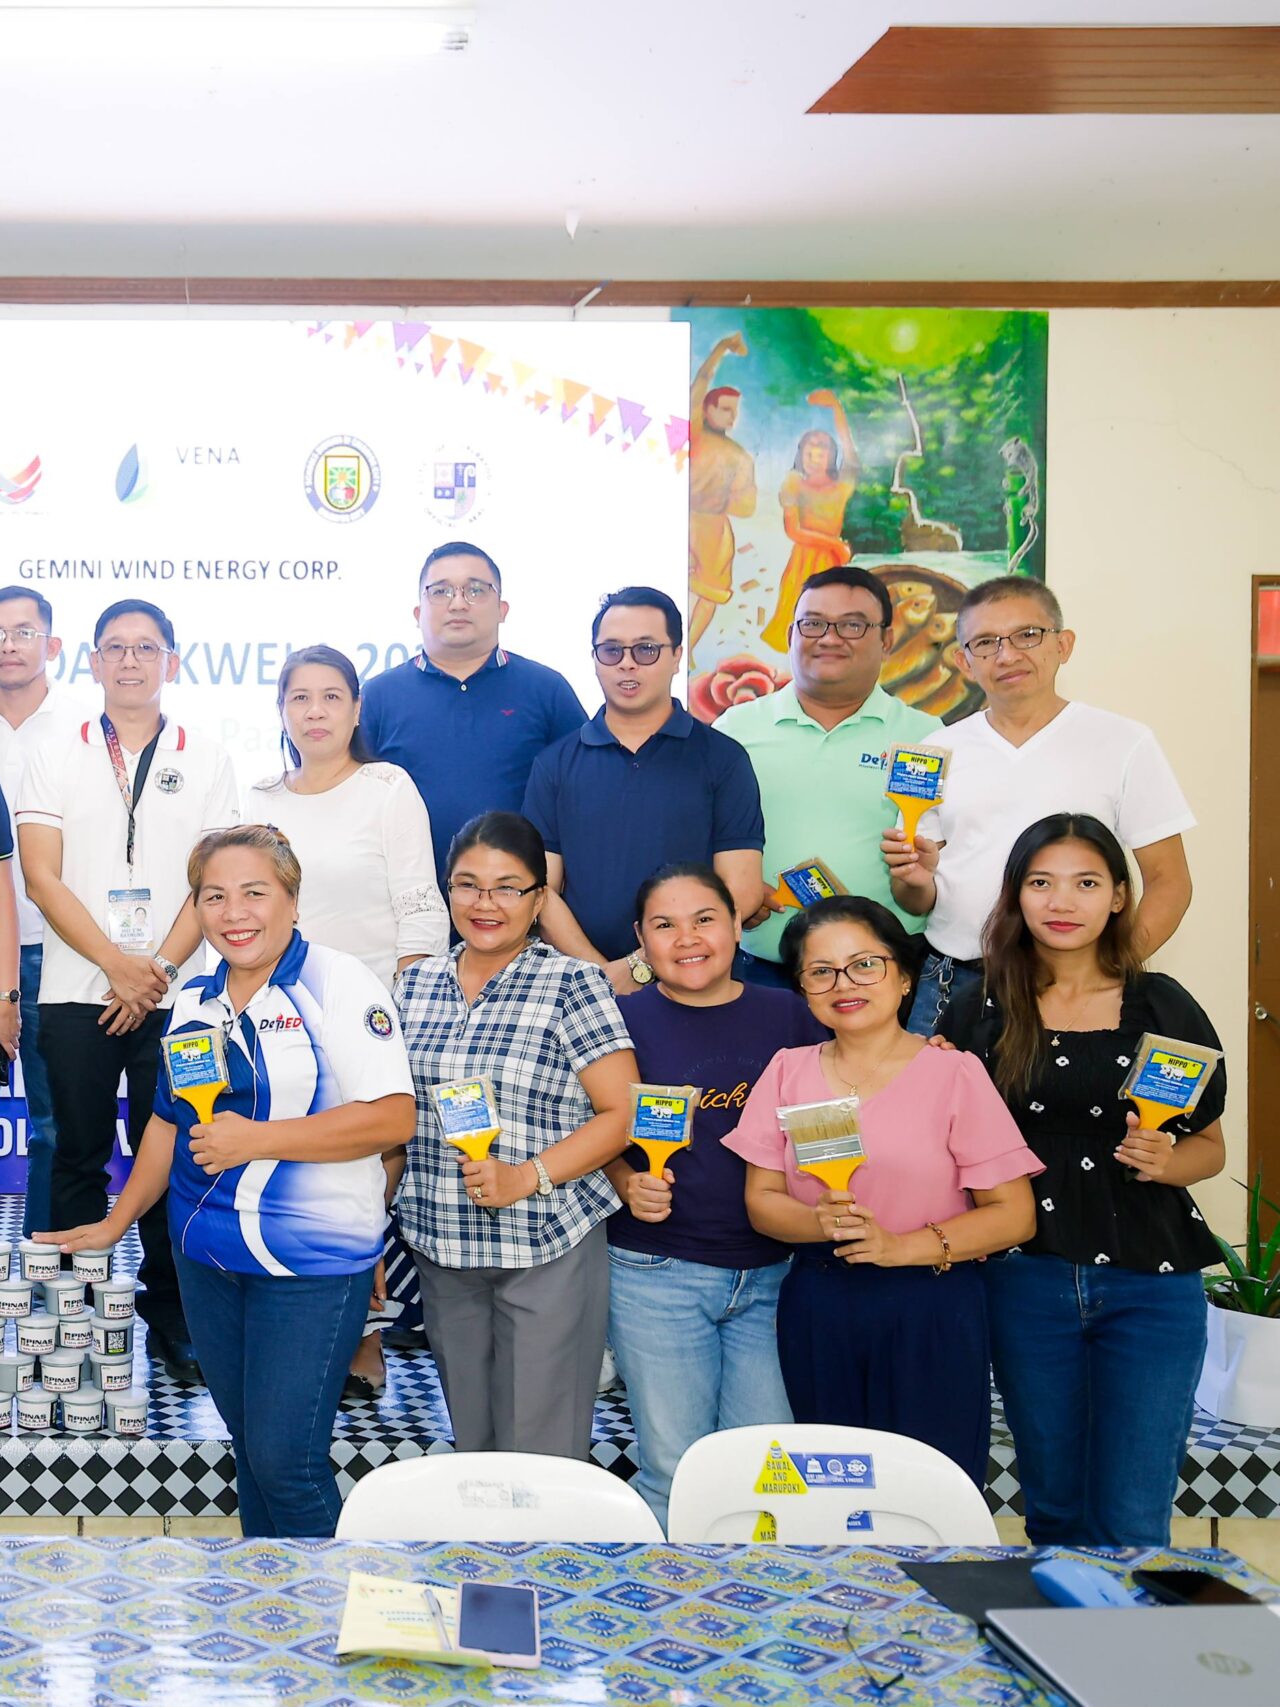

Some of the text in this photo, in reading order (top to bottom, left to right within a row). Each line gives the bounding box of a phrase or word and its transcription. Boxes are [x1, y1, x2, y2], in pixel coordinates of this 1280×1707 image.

[176, 446, 240, 465] VENA
[19, 560, 342, 580] GEMINI WIND ENERGY CORP.
[911, 756, 927, 764] HIPPO
[259, 1016, 303, 1033] DepED
[183, 1040, 199, 1049] HIPPO
[1167, 1058, 1188, 1068] HIPPO
[766, 1461, 791, 1471] BAWAL
[773, 1472, 787, 1481] ANG
[762, 1483, 800, 1493] MARUPOK!
